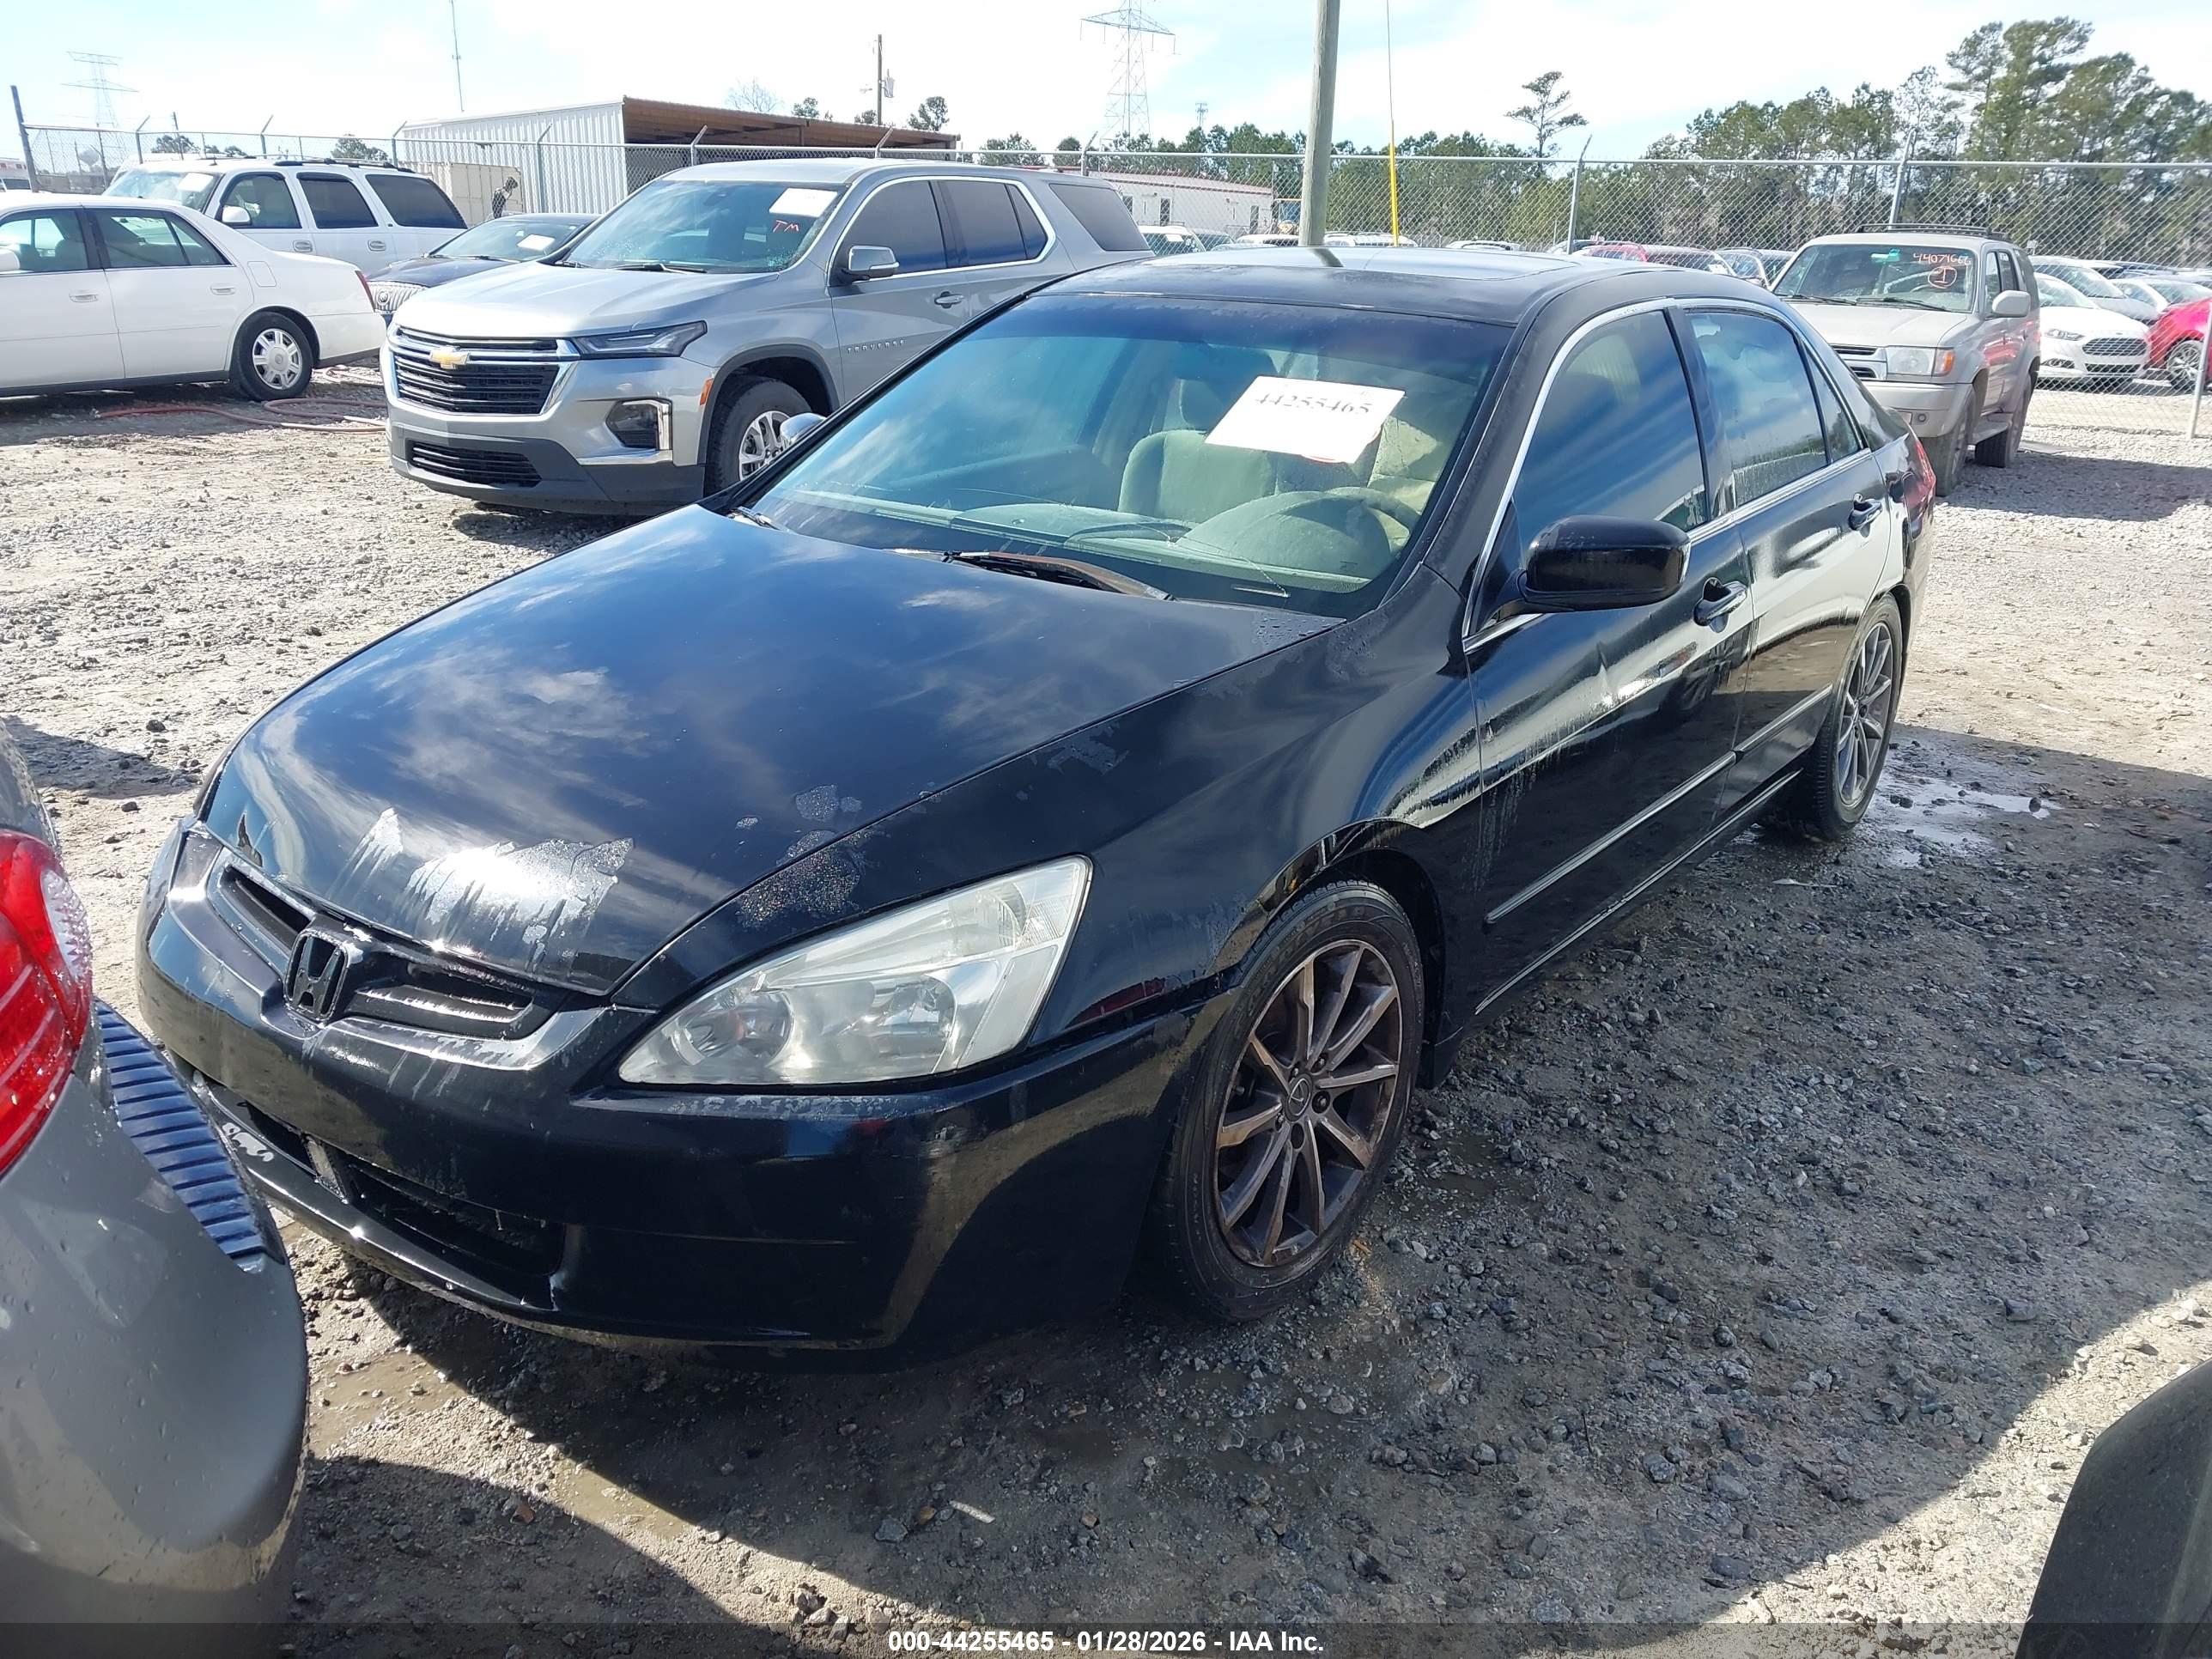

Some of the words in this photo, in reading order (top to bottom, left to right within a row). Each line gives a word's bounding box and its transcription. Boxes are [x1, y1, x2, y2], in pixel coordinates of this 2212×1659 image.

[773, 219, 799, 234] TM
[847, 338, 905, 354] TRAVERSE
[1255, 392, 1373, 415] 44255465
